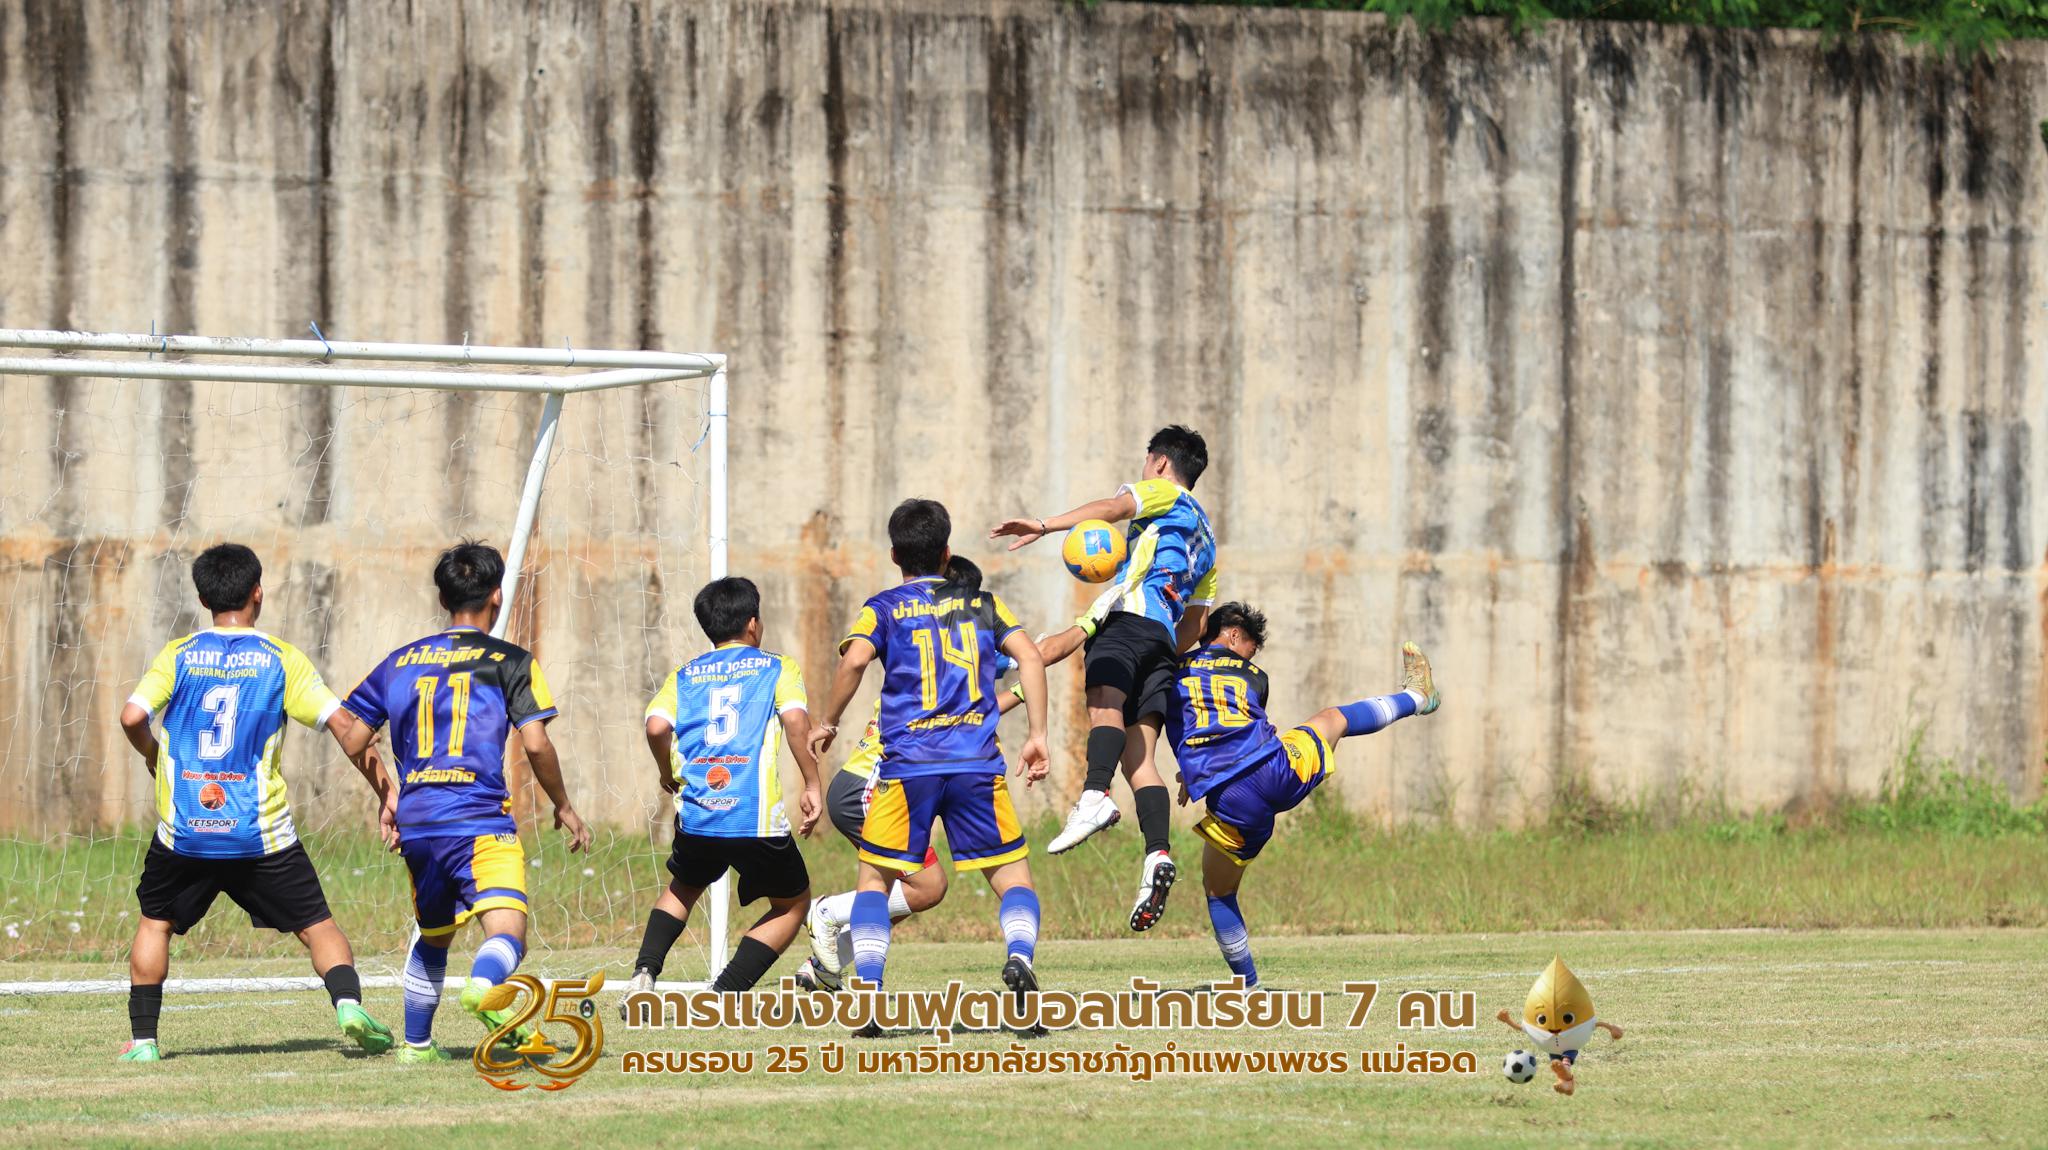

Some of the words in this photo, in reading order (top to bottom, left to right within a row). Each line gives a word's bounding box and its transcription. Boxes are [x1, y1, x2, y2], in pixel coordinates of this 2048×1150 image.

[184, 650, 223, 666] SAINT
[224, 651, 272, 668] JOSEPH
[685, 661, 723, 676] SAINT
[724, 658, 772, 674] JOSEPH
[912, 621, 984, 712] 14
[198, 684, 240, 760] 3
[415, 672, 472, 760] 11
[704, 682, 742, 746] 5
[1181, 674, 1254, 729] 10
[188, 818, 238, 828] KETSPORT
